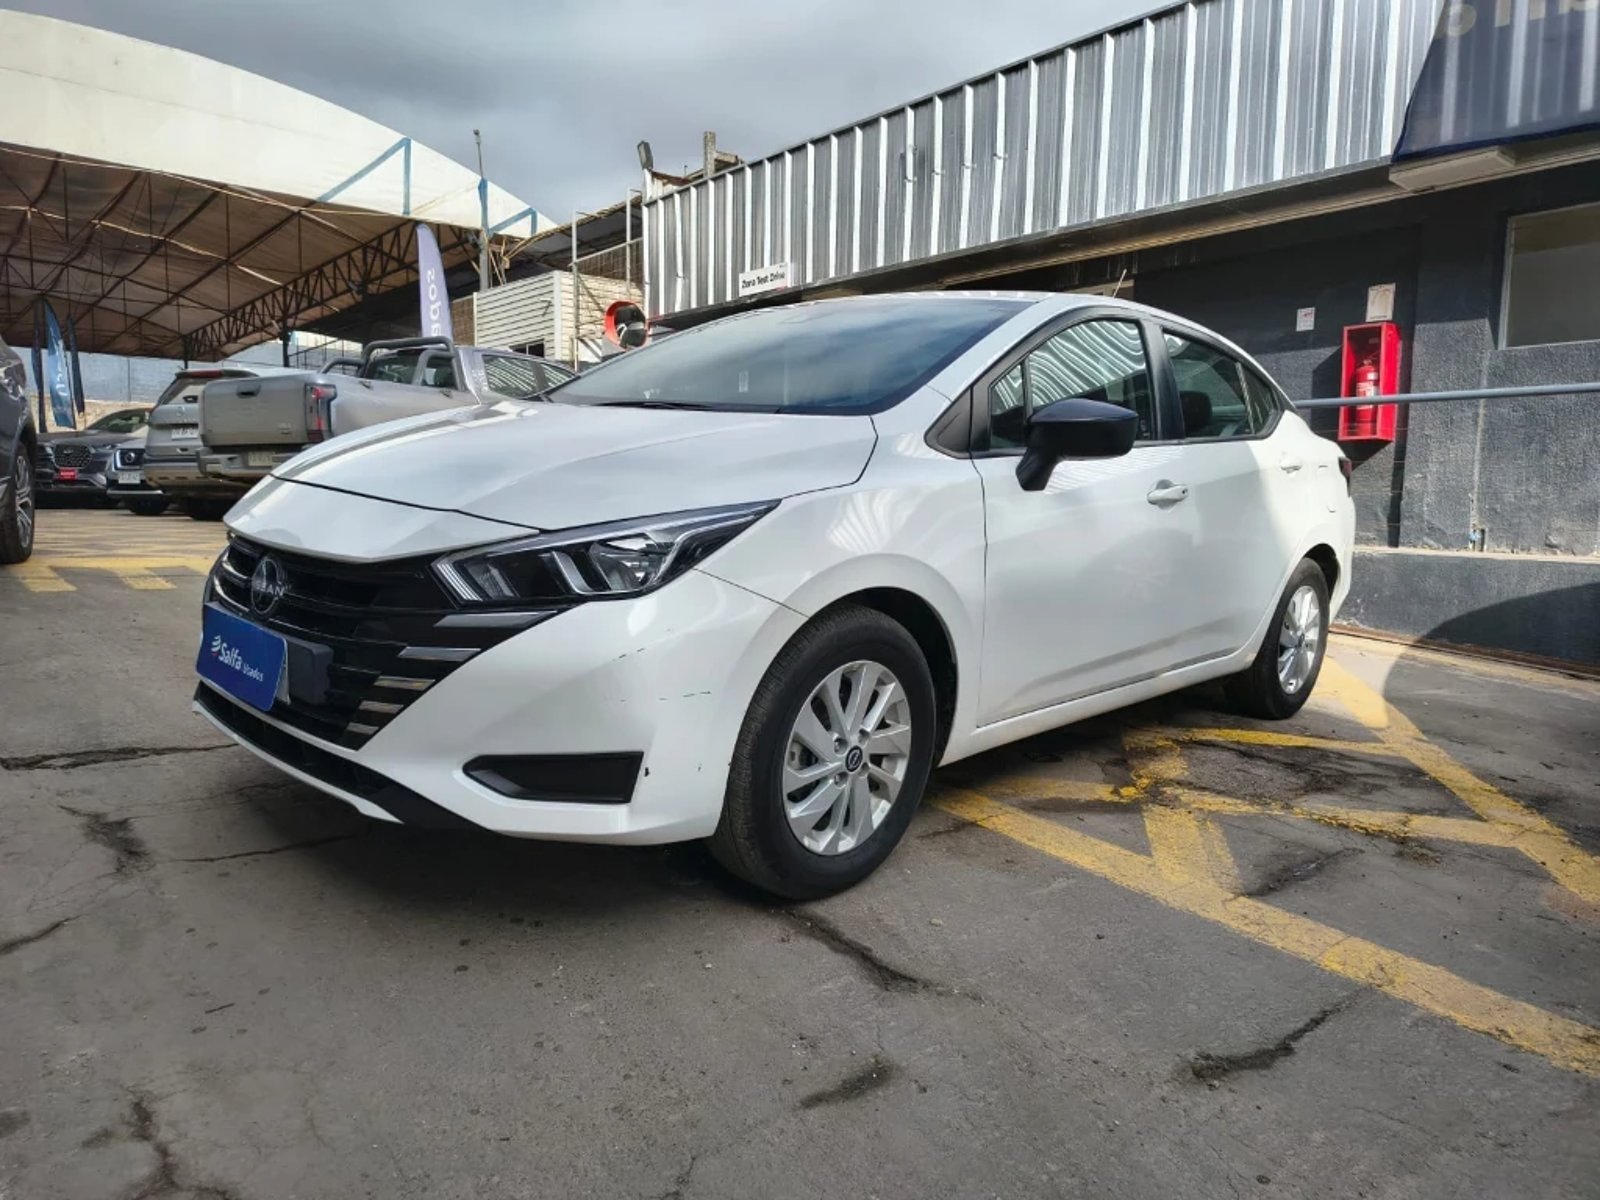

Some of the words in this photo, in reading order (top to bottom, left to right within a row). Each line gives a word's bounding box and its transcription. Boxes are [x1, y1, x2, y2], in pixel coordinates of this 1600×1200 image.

[757, 275, 769, 285] Test
[770, 271, 785, 282] Drive
[218, 642, 242, 670] Salfa
